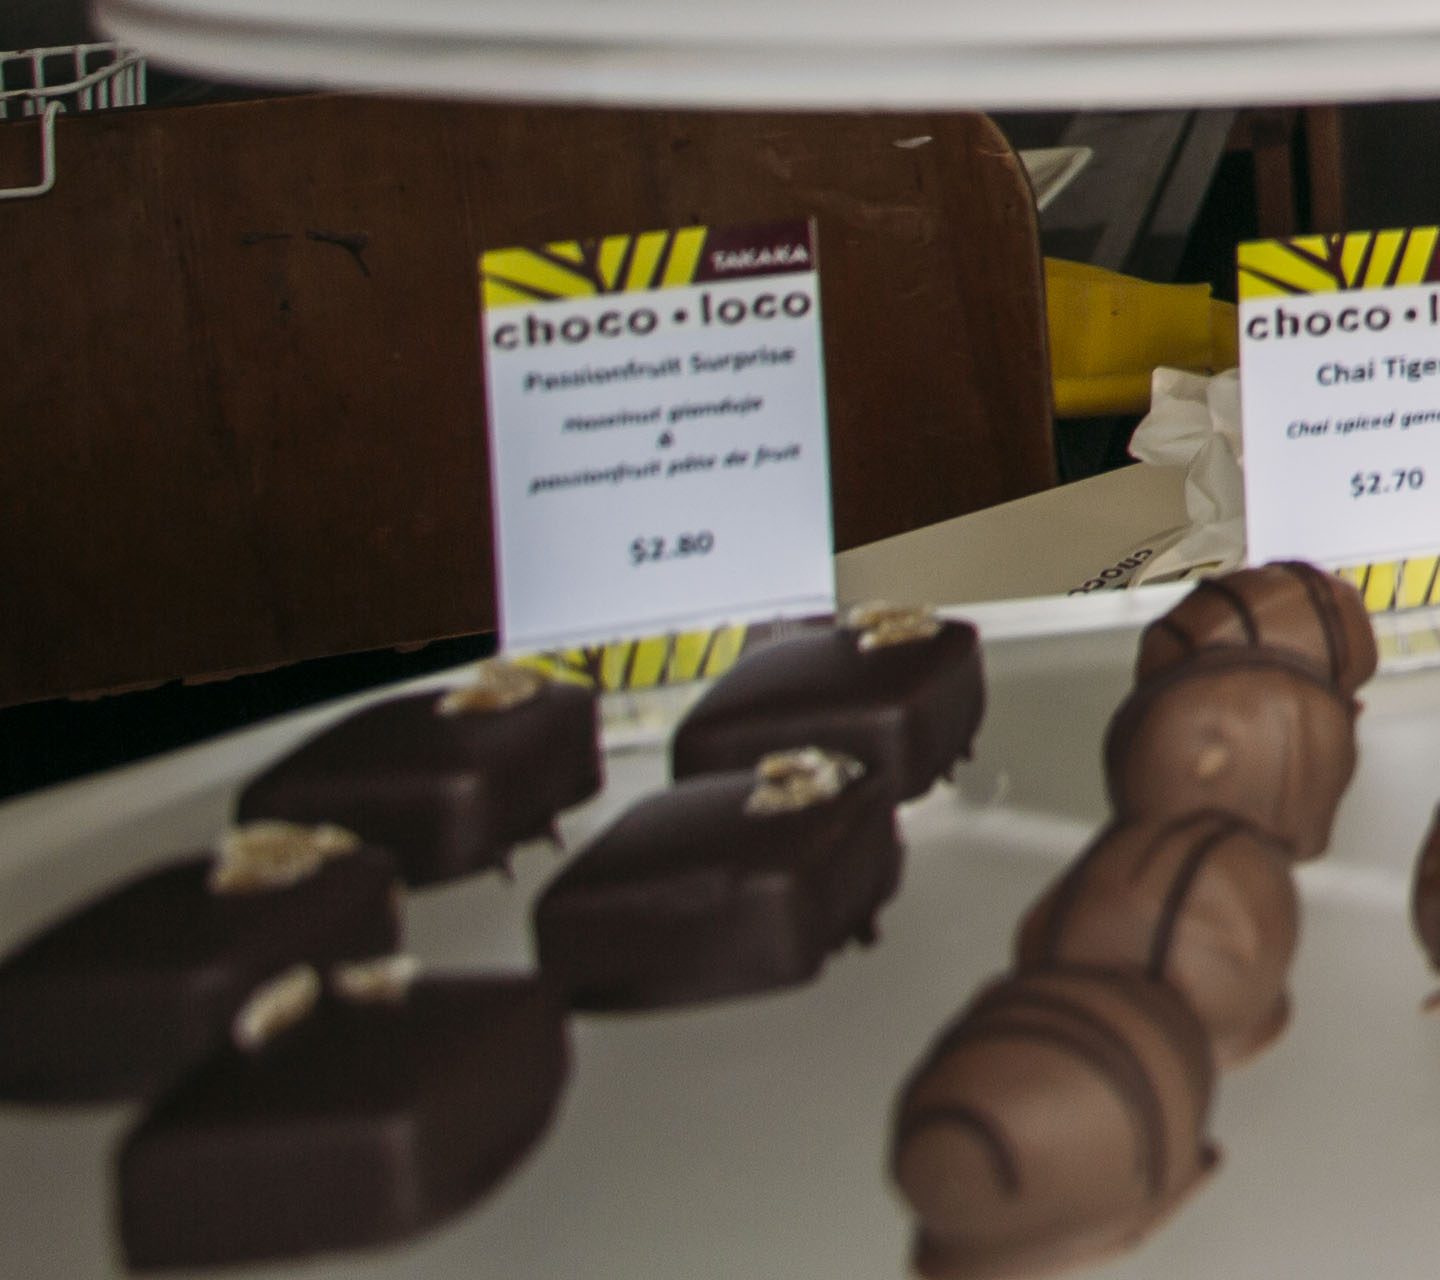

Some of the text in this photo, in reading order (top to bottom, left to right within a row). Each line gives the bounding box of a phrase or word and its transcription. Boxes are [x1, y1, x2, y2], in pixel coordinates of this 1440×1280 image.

[712, 243, 809, 270] TAKAKA
[493, 290, 812, 351] choco loco
[1246, 305, 1391, 340] choco
[524, 345, 796, 393] Passionfruit Surprise
[1316, 361, 1376, 387] Chai
[1286, 420, 1329, 440] Chai
[1334, 411, 1395, 436] spiced
[1350, 466, 1424, 499] $2.70
[628, 530, 715, 566] $2.80
